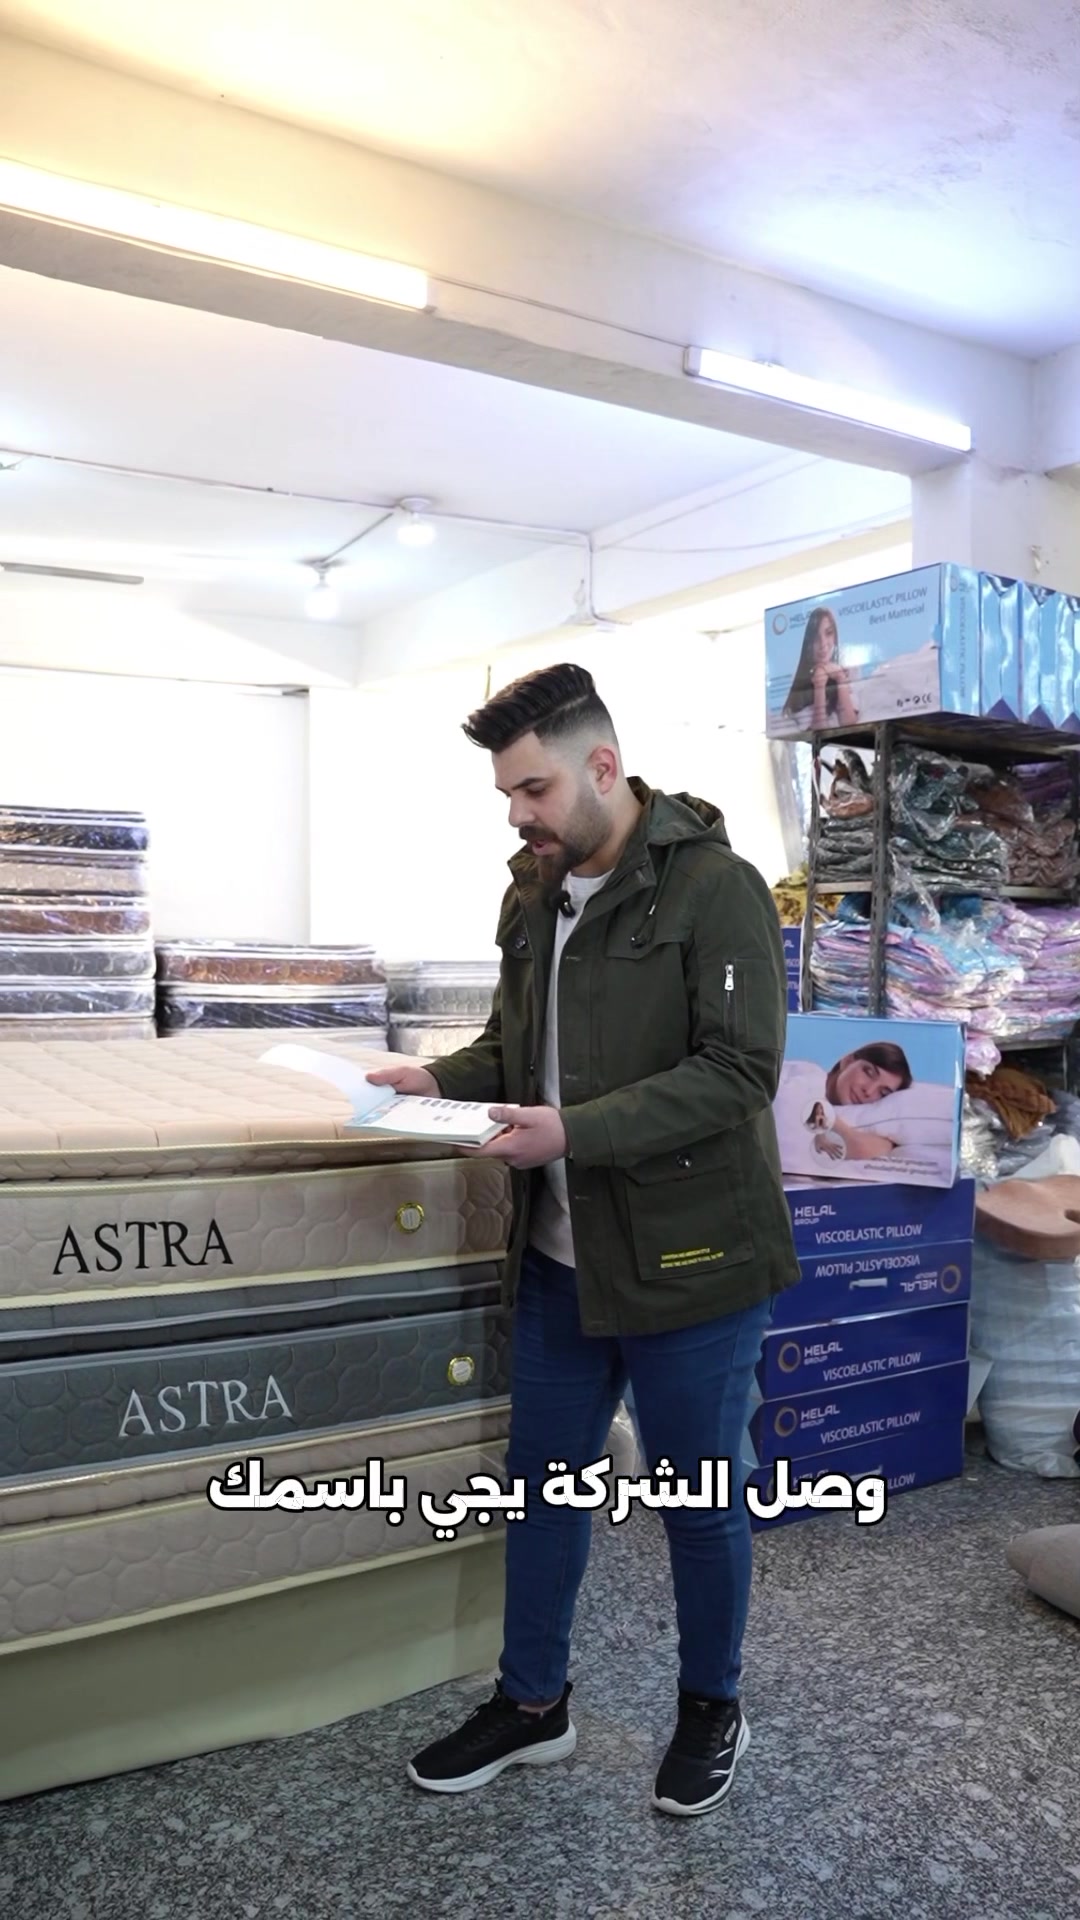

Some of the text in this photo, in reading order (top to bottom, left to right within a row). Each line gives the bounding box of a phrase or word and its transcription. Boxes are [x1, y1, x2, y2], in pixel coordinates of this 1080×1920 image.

[838, 587, 928, 616] VISCOELASTIC PILLOW
[869, 613, 887, 625] Best
[794, 1205, 836, 1218] HELAL
[794, 1218, 820, 1226] GROUP
[815, 1224, 923, 1244] VISCOELASTIC PILLOW
[53, 1218, 234, 1275] ASTRA
[815, 1255, 921, 1278] VISCOELASTIC PILLOW
[900, 1279, 938, 1293] HELAL
[804, 1341, 843, 1358] HELAL
[823, 1352, 921, 1381] VISCOELASTIC PILLOW
[118, 1374, 293, 1438] ASTRA
[801, 1404, 840, 1421] HELAL
[820, 1411, 921, 1444] VISCOELASTIC PILLOW
[887, 1473, 916, 1490] ILLOW
